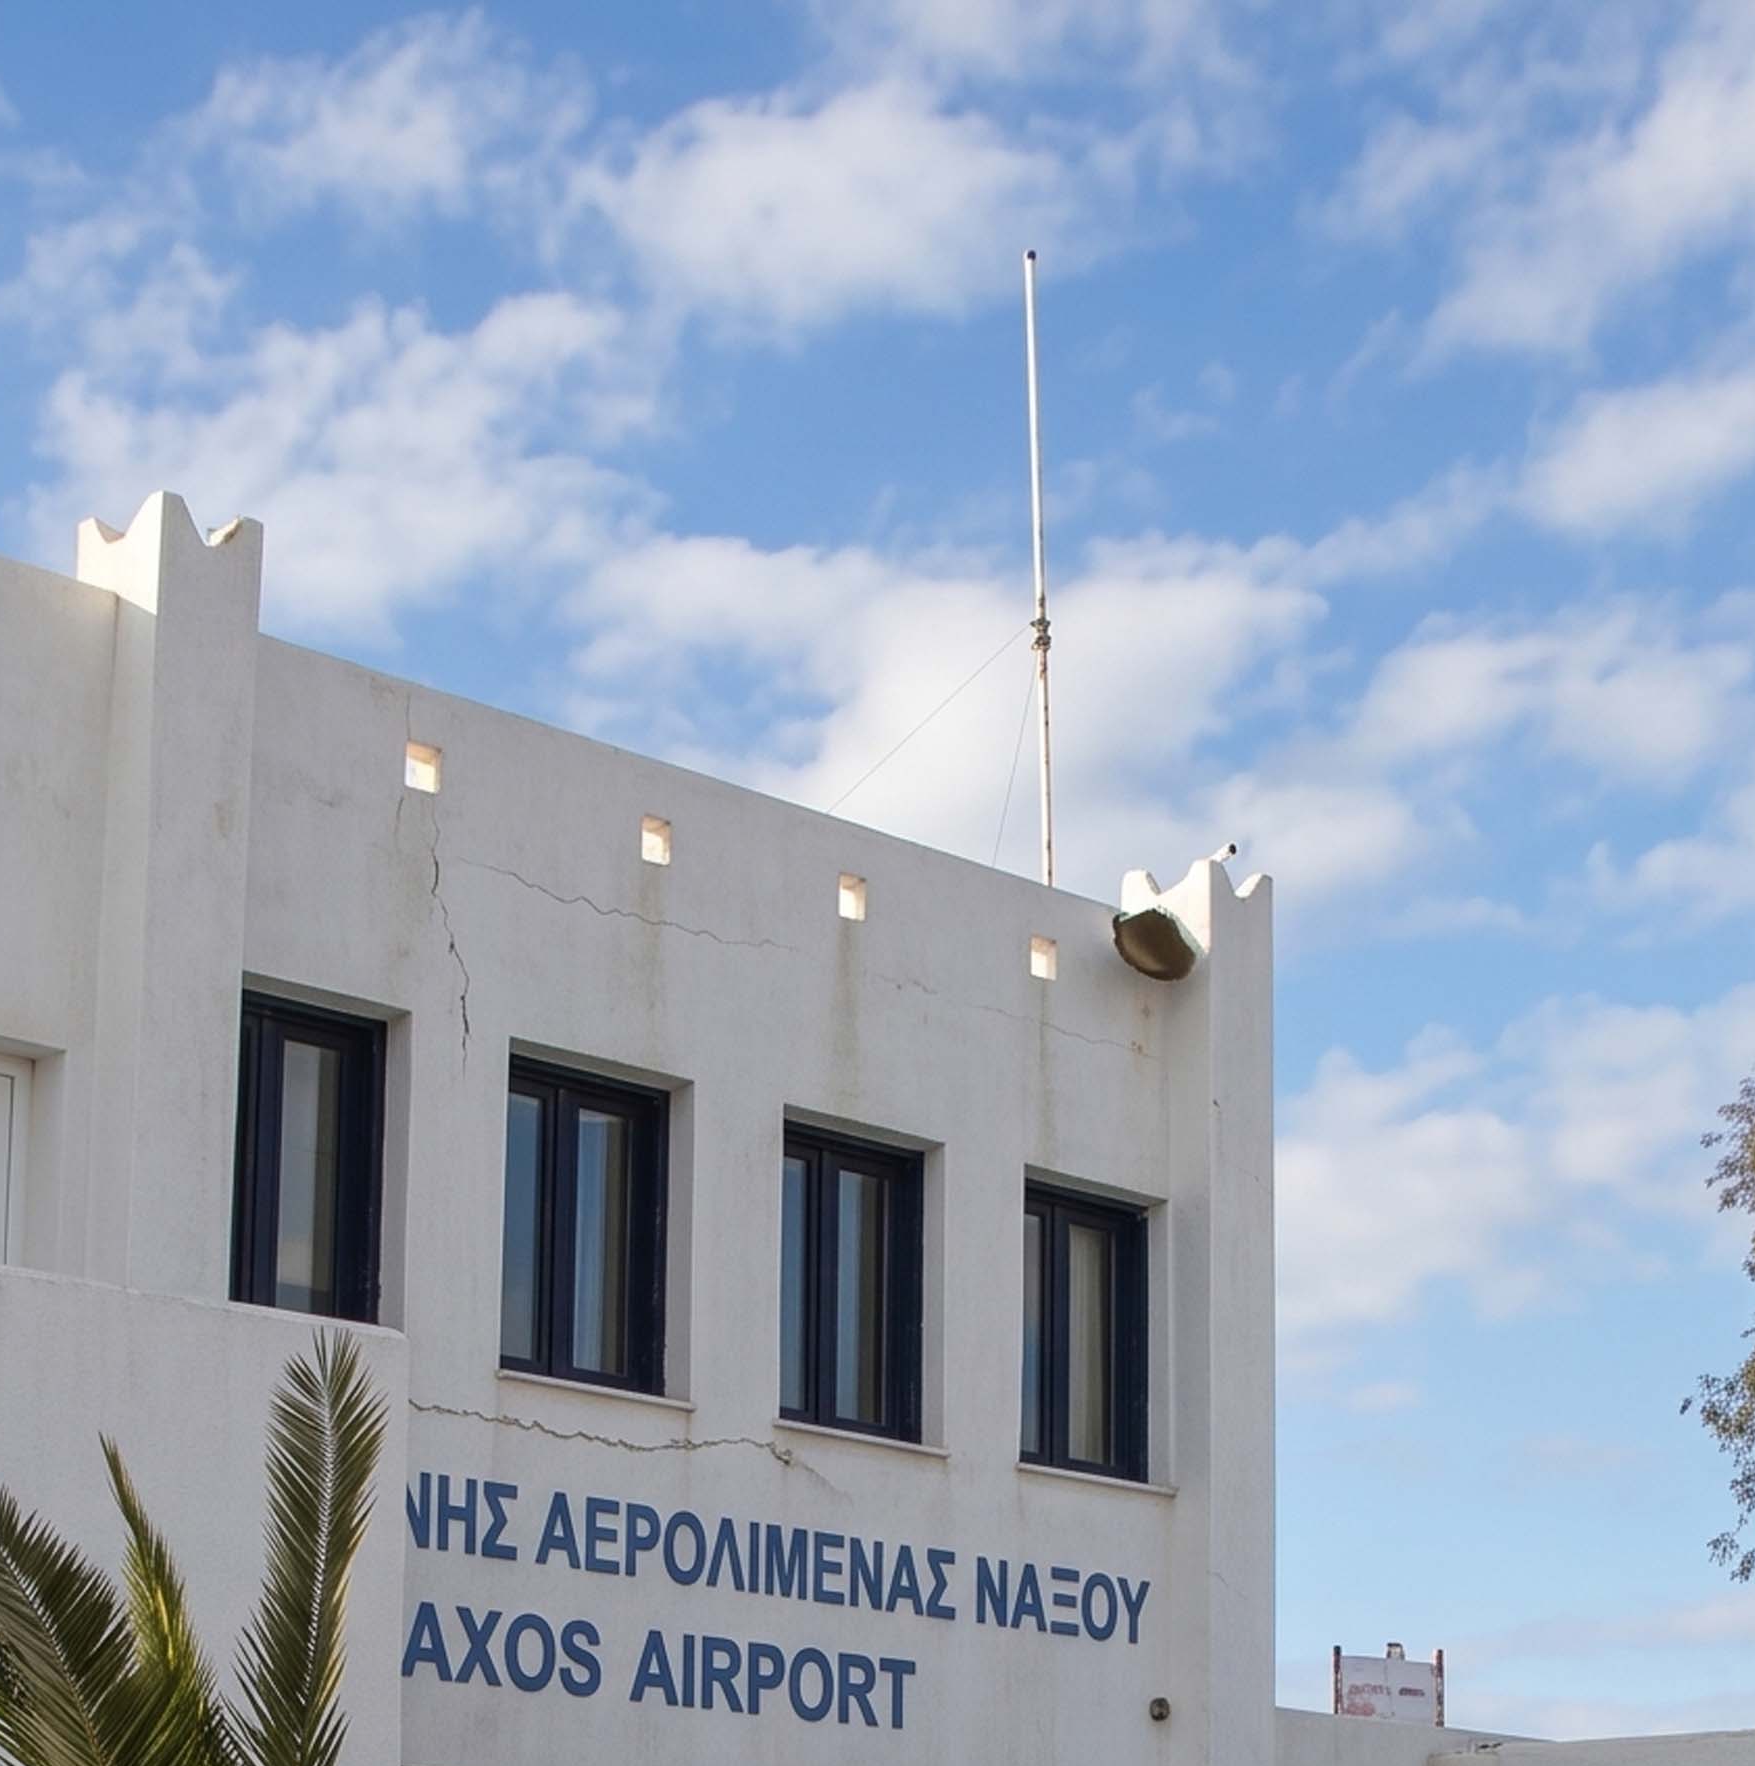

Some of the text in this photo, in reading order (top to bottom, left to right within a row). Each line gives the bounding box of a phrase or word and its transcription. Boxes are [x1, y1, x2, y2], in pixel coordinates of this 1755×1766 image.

[405, 1471, 1150, 1644] ΝΗΣ ΑΕΡΟΛΙΜΕΝΑΣ ΝΑΞΟΥ
[401, 1600, 917, 1730] AXOS AIRPORT
